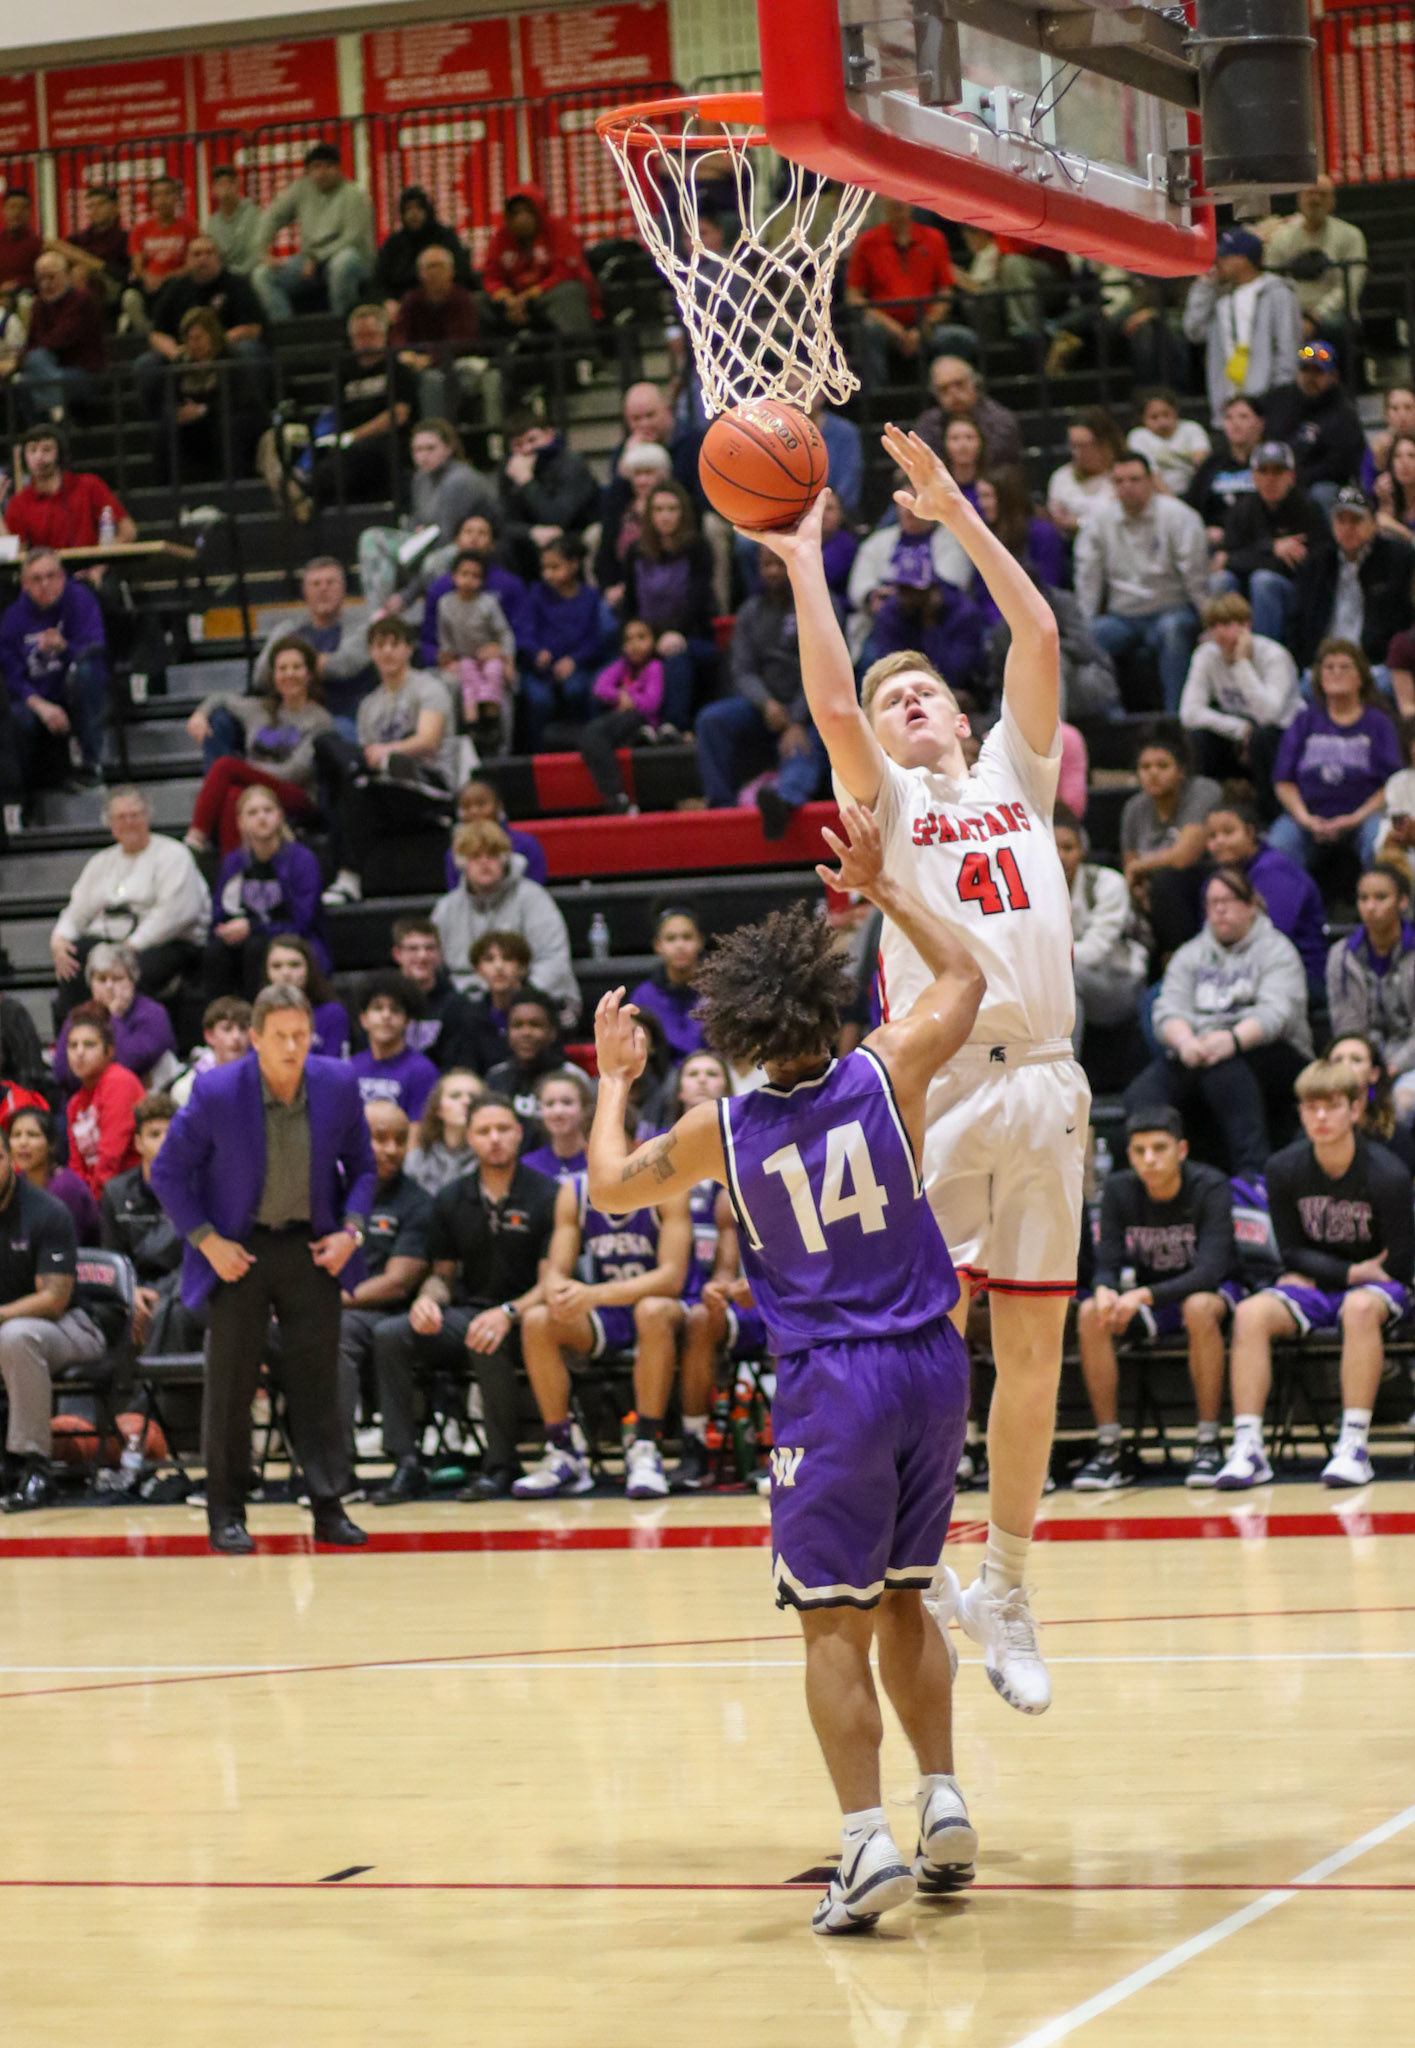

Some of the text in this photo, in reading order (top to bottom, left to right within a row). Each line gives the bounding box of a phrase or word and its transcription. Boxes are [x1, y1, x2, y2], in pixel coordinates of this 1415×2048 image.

[912, 802, 1031, 846] SPARTANS
[956, 846, 1031, 916] 41
[762, 1119, 889, 1254] 14
[769, 1446, 805, 1487] W
